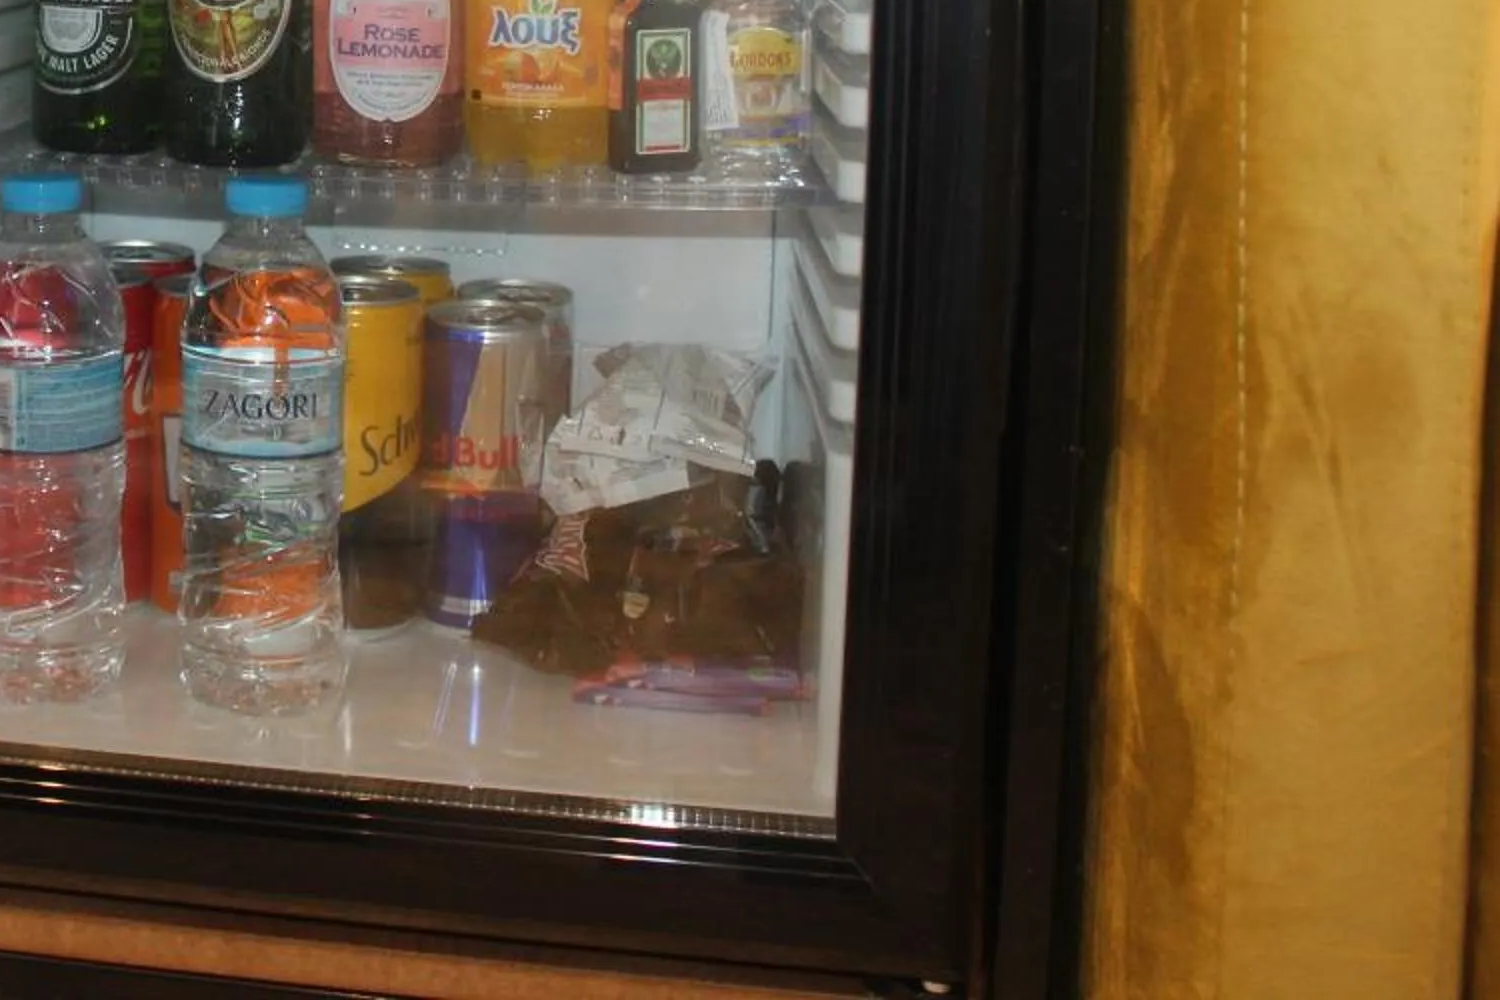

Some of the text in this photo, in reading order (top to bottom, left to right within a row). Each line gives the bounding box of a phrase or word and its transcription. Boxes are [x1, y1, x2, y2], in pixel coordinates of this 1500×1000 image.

[363, 23, 421, 43] ROSE
[83, 33, 121, 70] LAGER
[336, 37, 446, 60] LEMONADE
[203, 389, 318, 421] ZAGORI
